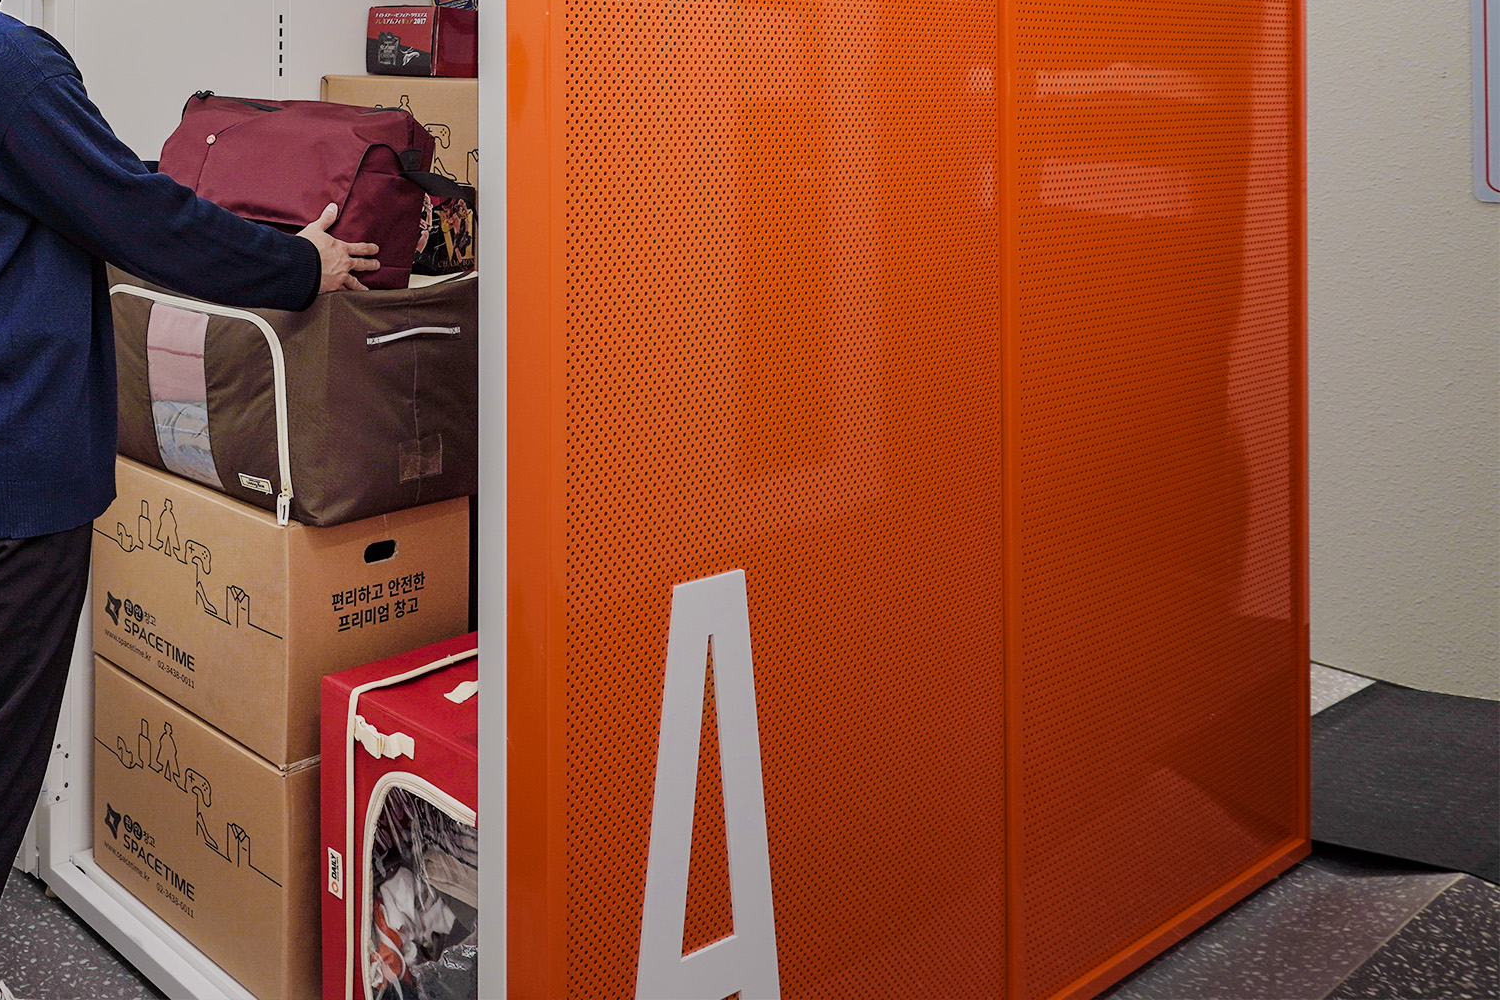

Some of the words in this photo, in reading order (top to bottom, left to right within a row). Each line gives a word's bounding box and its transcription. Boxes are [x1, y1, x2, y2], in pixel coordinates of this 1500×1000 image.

[331, 583, 384, 612] 편리하고
[387, 571, 426, 598] 안전한
[337, 602, 389, 632] 프리미엄
[393, 596, 419, 619] 창고
[123, 618, 195, 673] SPACETIME
[157, 660, 195, 690] 02-3438-0011
[634, 568, 781, 1000] A
[123, 833, 195, 902] SPACETIME
[156, 882, 195, 919] 02-3438-0011
